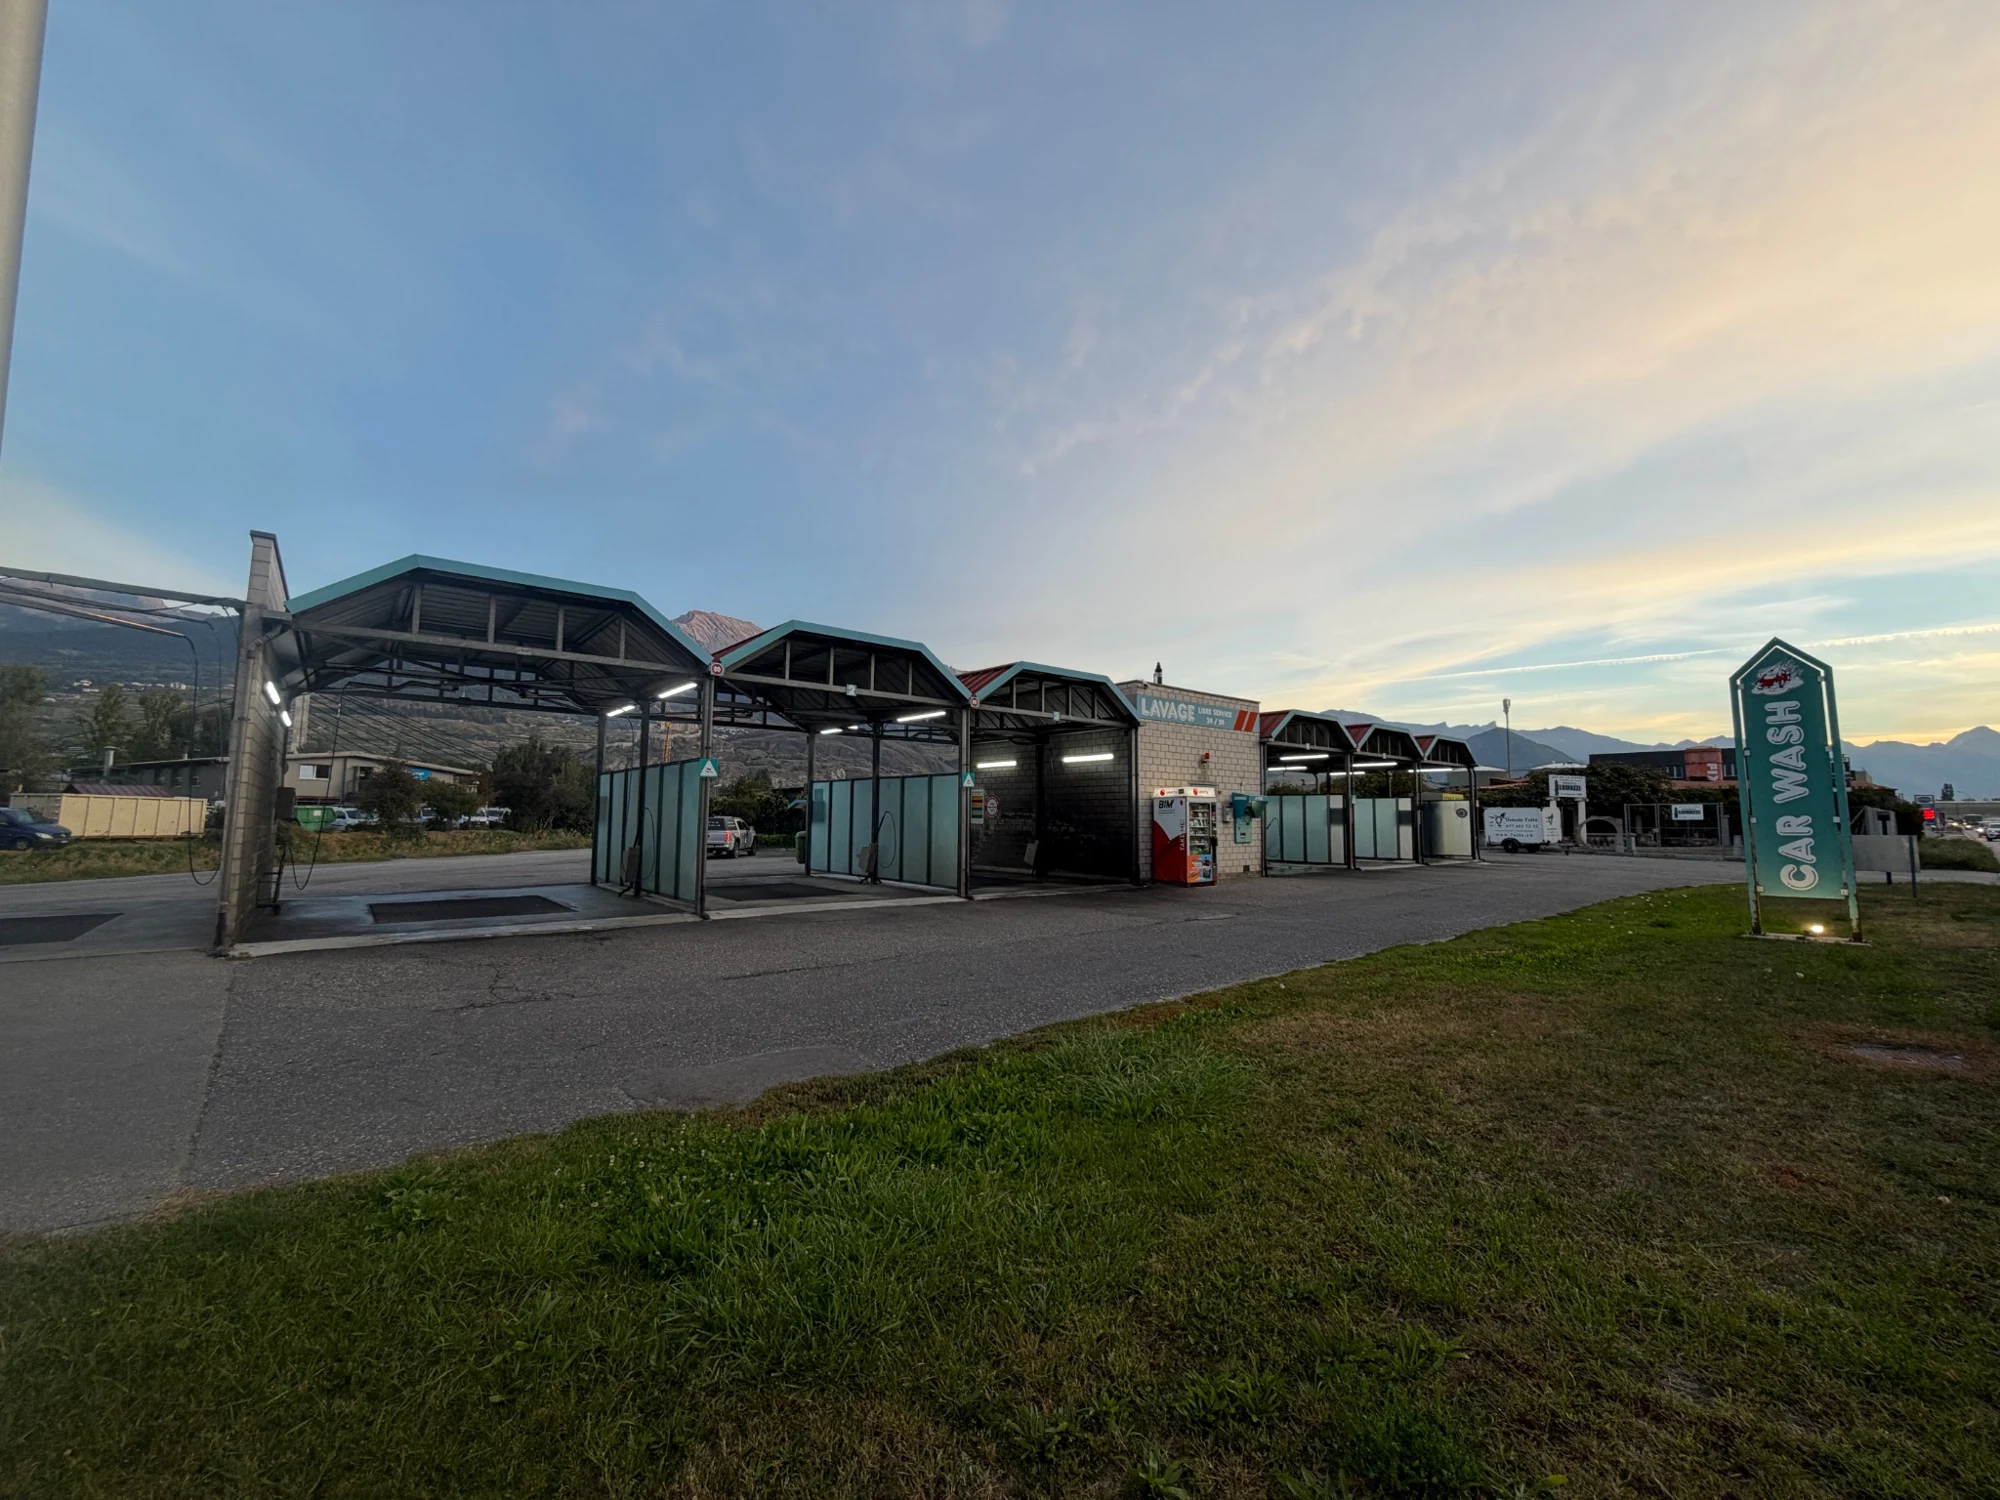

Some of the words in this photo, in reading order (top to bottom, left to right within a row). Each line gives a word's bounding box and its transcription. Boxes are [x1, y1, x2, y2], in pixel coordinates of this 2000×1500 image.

[1141, 698, 1195, 722] LAVAGE
[1198, 707, 1212, 715] LIBRE
[1213, 709, 1232, 718] SERVICE
[1764, 700, 1810, 804] WASH
[1159, 799, 1174, 809] BIM
[1775, 815, 1819, 891] CAR
